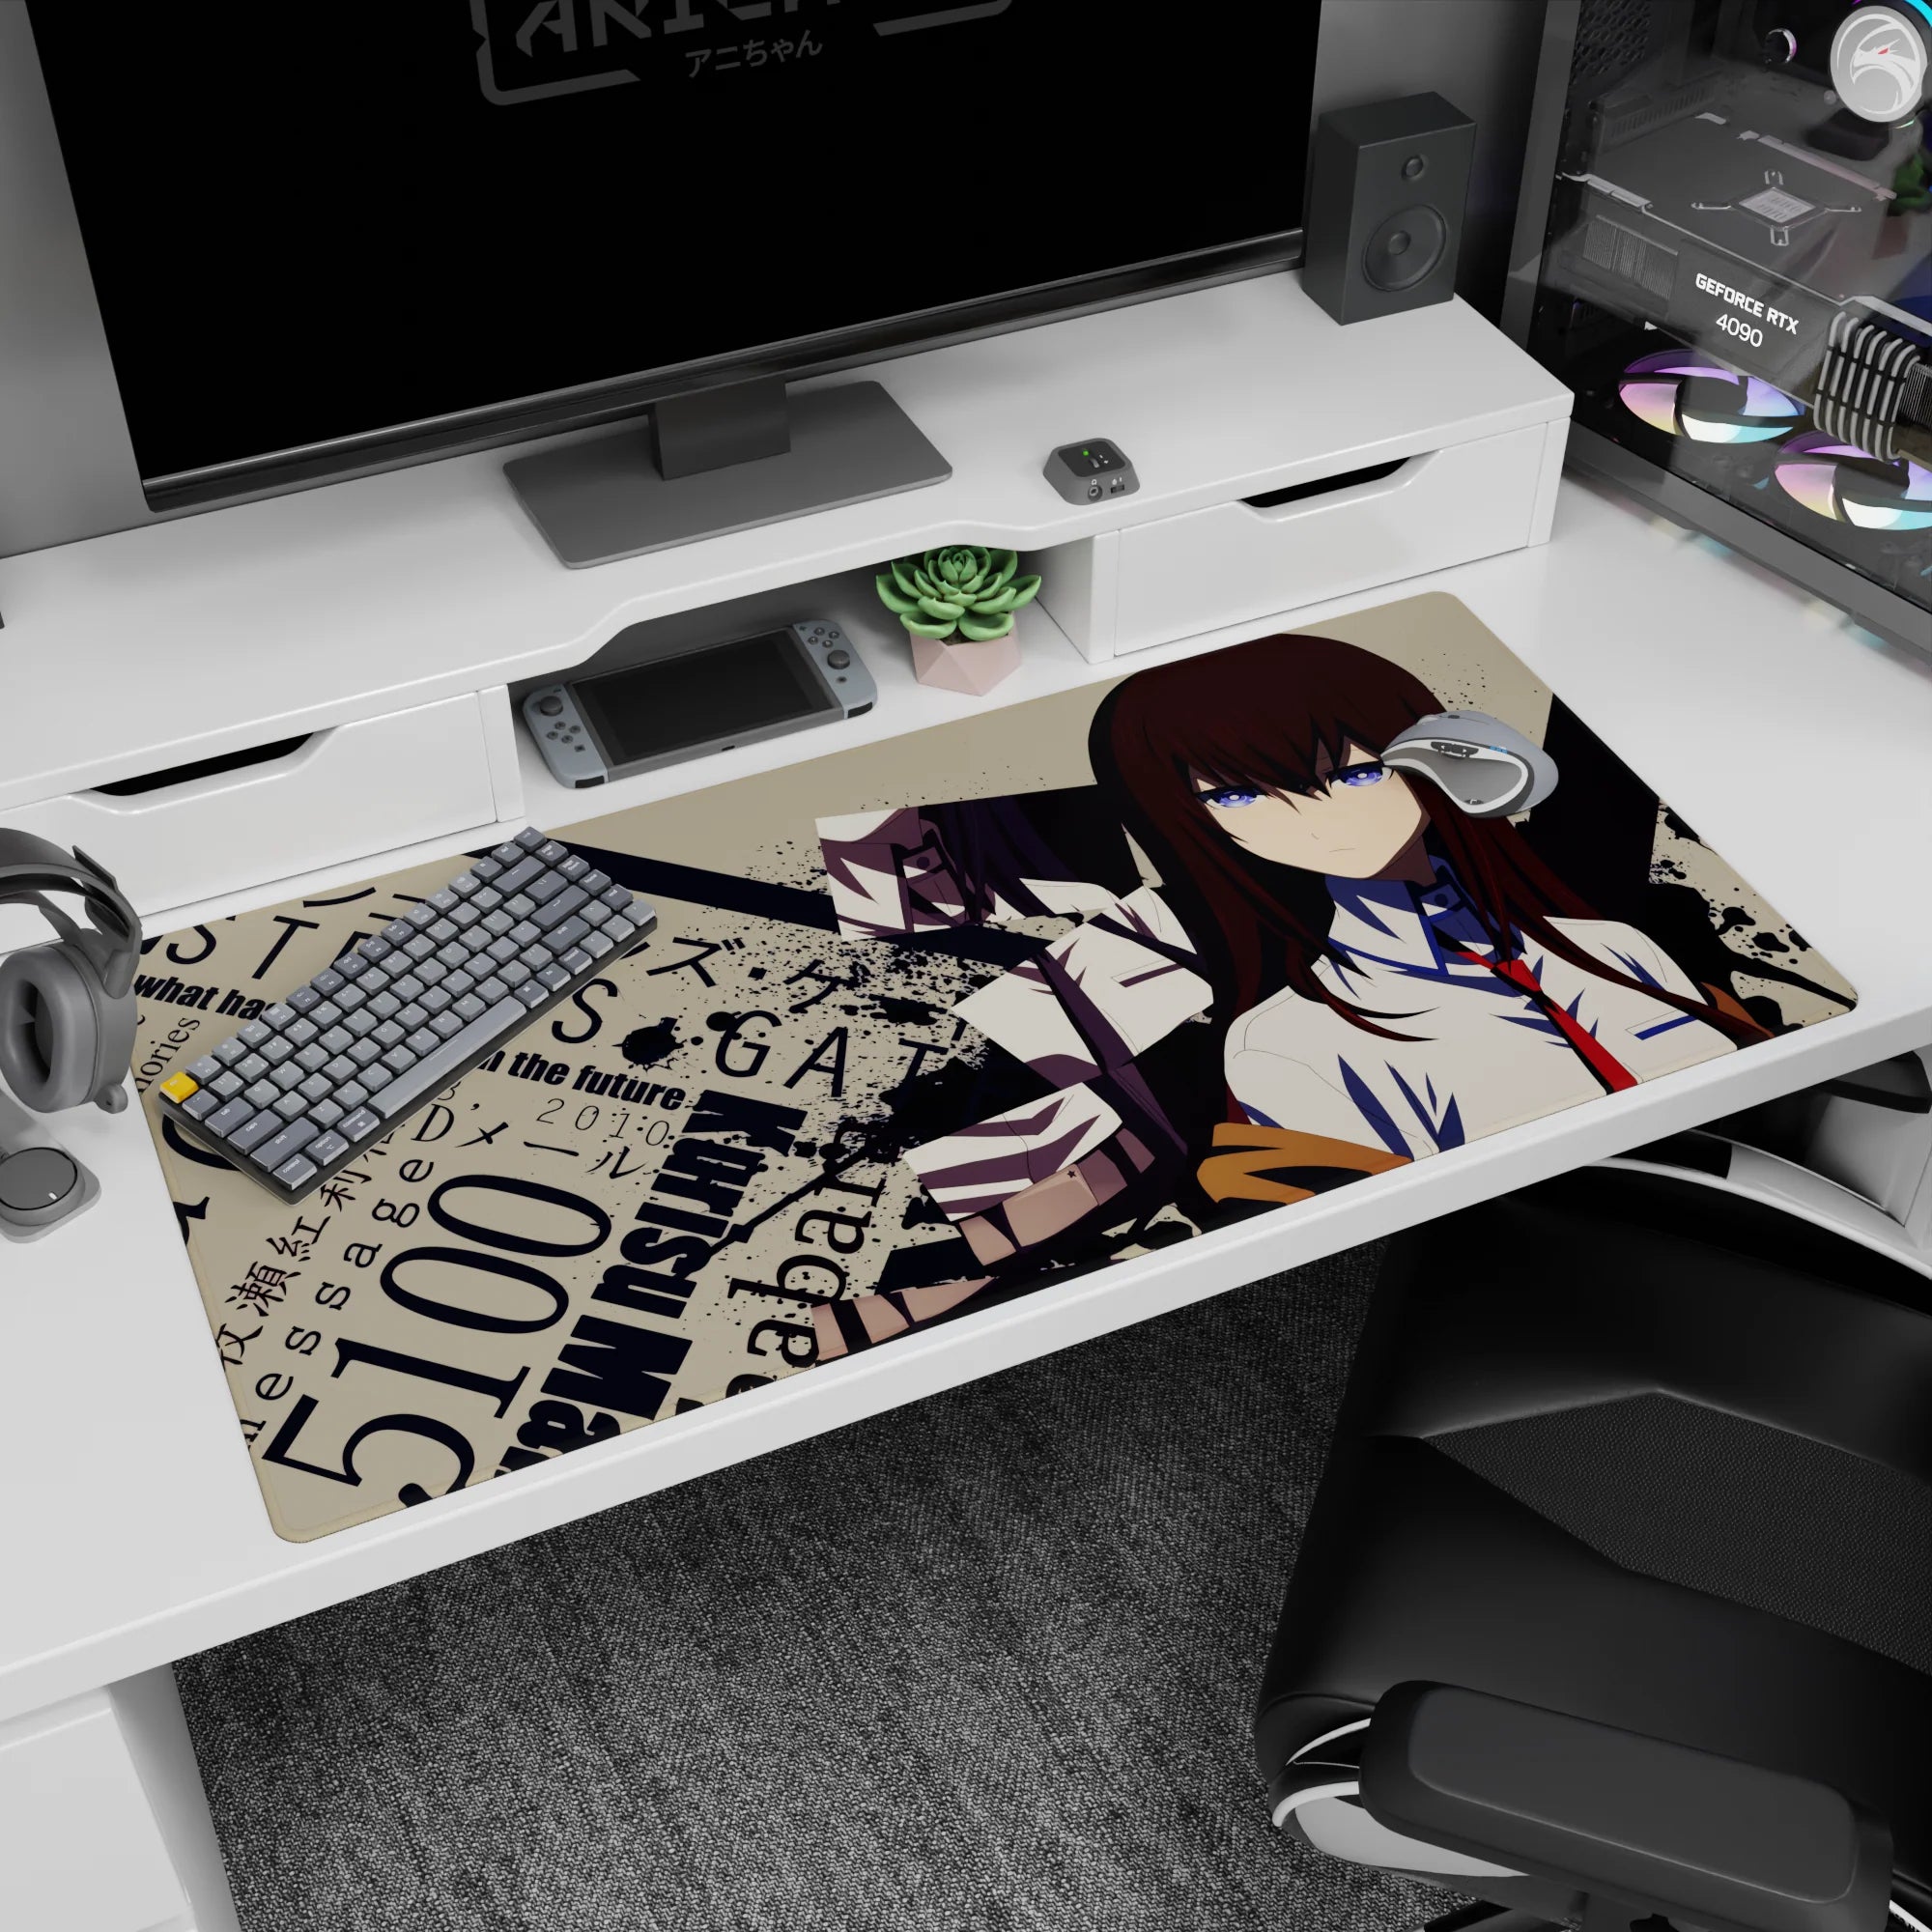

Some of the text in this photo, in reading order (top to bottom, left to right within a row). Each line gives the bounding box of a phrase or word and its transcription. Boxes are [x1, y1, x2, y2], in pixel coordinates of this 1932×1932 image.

[686, 30, 822, 77] アニちゃん
[1695, 272, 1800, 335] GEFORCE RTX
[1716, 313, 1764, 348] 4090
[133, 974, 219, 1010] what
[214, 988, 278, 1021] ha
[507, 1052, 570, 1086] the
[571, 1065, 686, 1111] future
[535, 1097, 670, 1147] 2010
